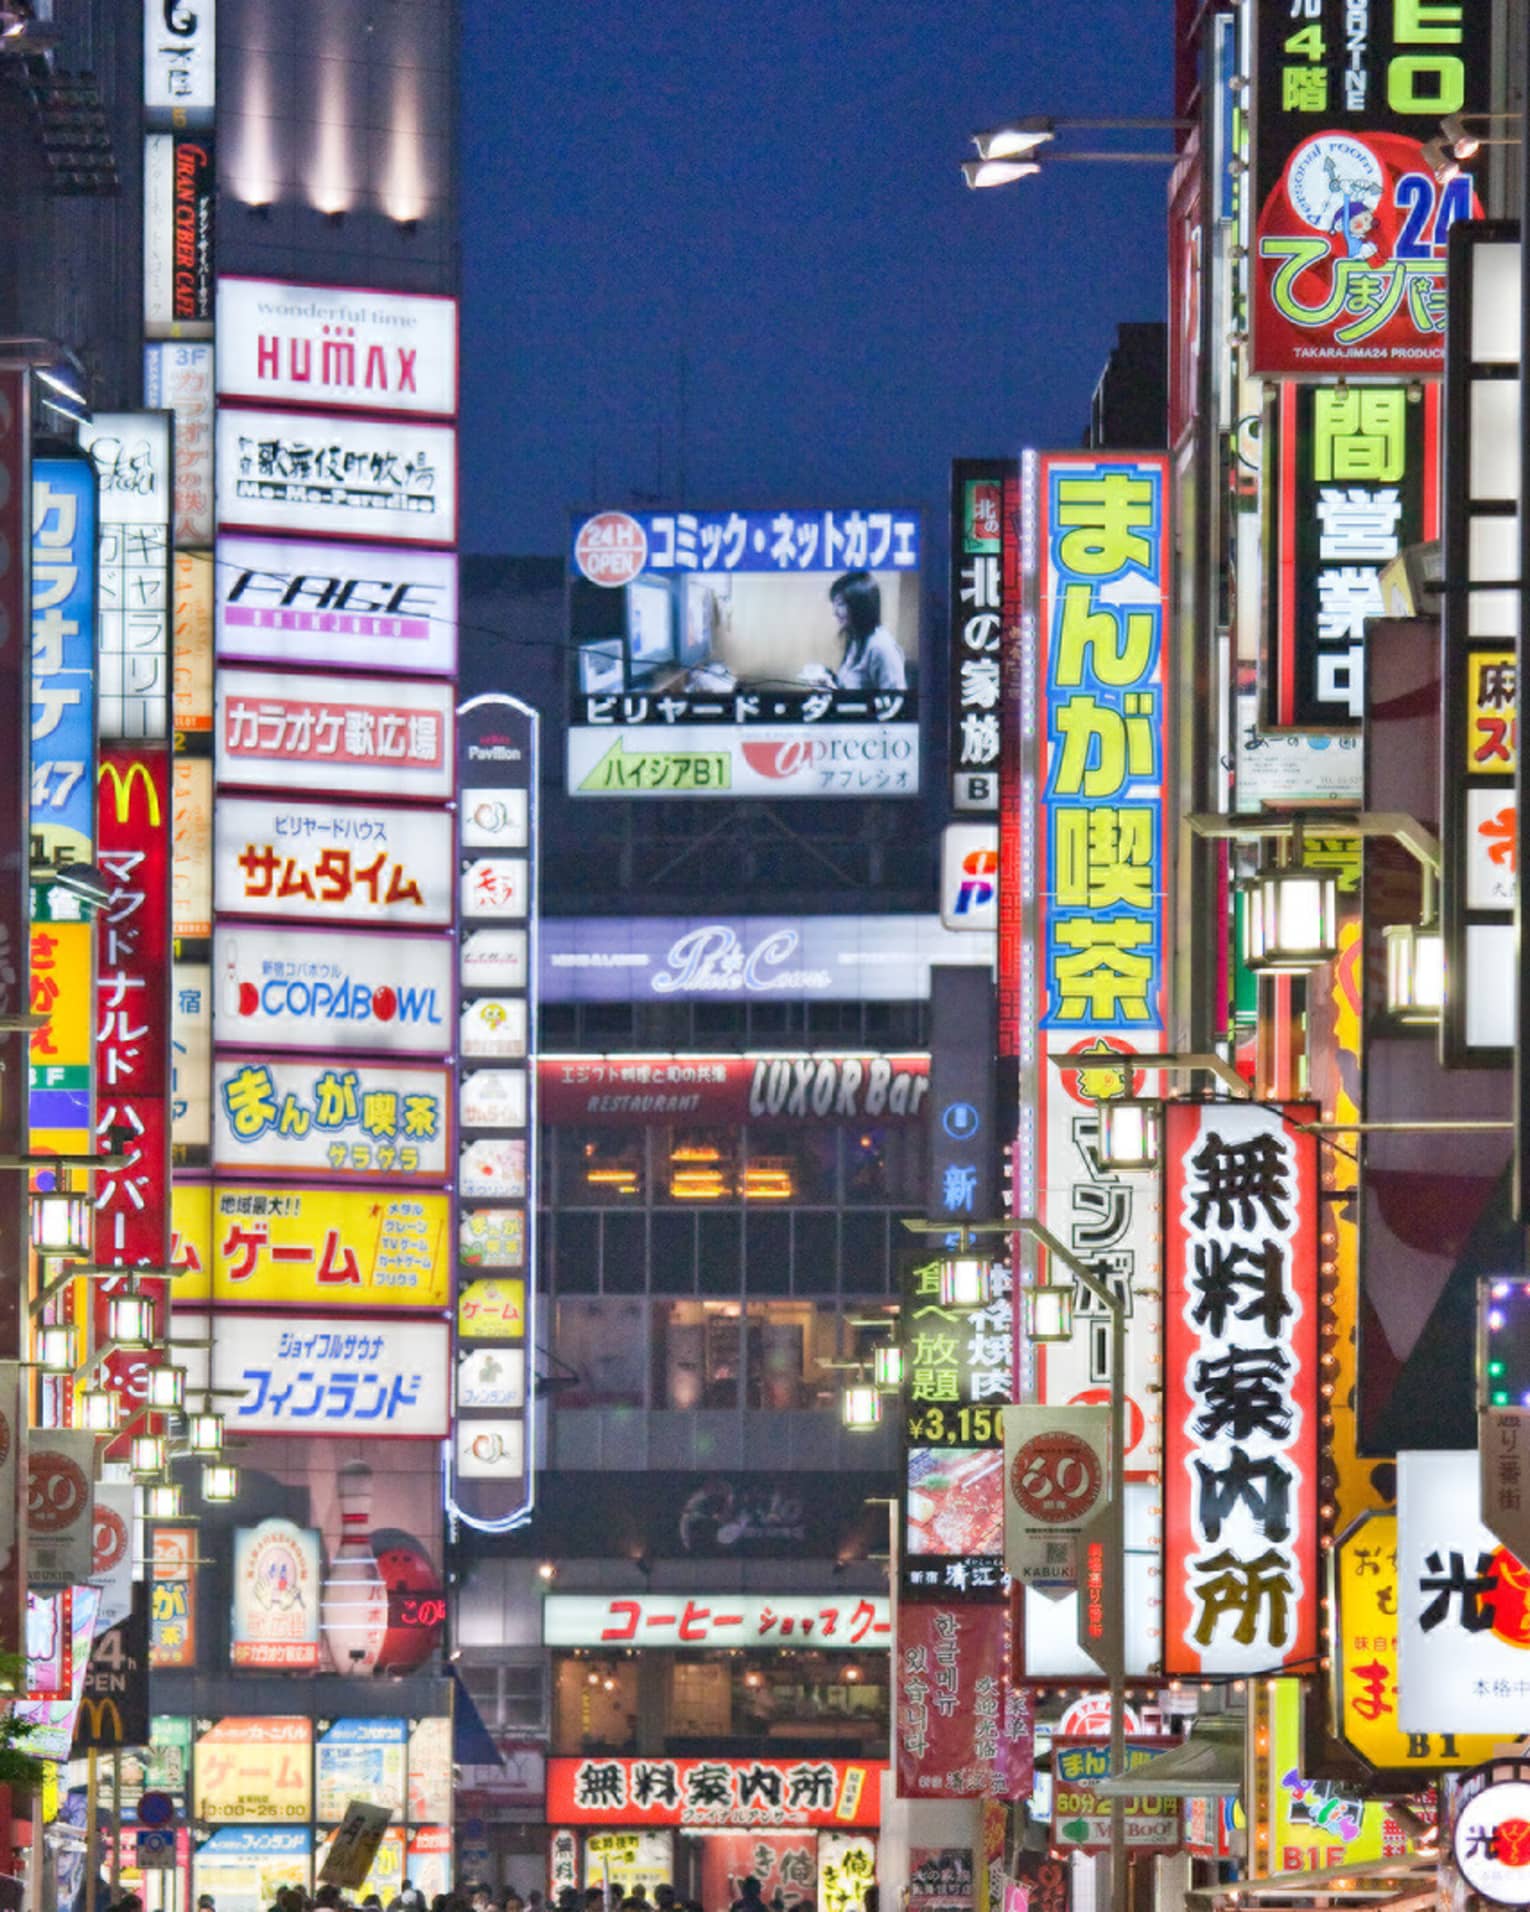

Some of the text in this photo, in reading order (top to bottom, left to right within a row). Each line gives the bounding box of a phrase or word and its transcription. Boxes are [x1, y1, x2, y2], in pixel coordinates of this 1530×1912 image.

[175, 143, 208, 203] GRAN
[1329, 143, 1376, 176] room
[176, 207, 196, 268] CYBER
[1393, 173, 1474, 259] 24
[257, 302, 417, 328] wonderful time
[176, 350, 205, 366] 3F
[258, 325, 416, 393] HUMAX
[1293, 347, 1445, 360] TAKARAJIMA24 PRODUC
[257, 440, 436, 491] 歌舞伎町牧場
[586, 523, 635, 548] 24H
[651, 512, 916, 570] コミック・ネットカフェ
[586, 553, 635, 576] OPEN
[227, 569, 447, 618] FACE
[127, 528, 166, 738] ギャラリー
[175, 558, 192, 705] PASSAGE
[959, 556, 1001, 765] 北の家族
[1476, 660, 1517, 710] 麻
[228, 703, 438, 761] カラオケ歌広場
[587, 695, 904, 724] ビリヤード・ダーツ
[174, 732, 187, 751] 2
[468, 746, 522, 761] Pavilion
[1053, 472, 1155, 1022] まんが喫茶
[1473, 716, 1517, 761] ス
[604, 755, 725, 788] ハイジアB1
[275, 816, 388, 841] ビリヤードハウス
[238, 843, 425, 906] サムタイム
[97, 850, 149, 1085] マクドナルド
[223, 1065, 440, 1142] まんが喫茶
[587, 1094, 700, 1113] RESTAURANT
[748, 1057, 930, 1118] LUXOR Bar
[328, 1143, 420, 1171] ゲラゲラ
[219, 1195, 301, 1216] 地域最大!!
[223, 1223, 361, 1285] ゲーム
[463, 1301, 520, 1321] ゲーム
[278, 1332, 385, 1361] ジョイフルサウナ
[238, 1369, 422, 1420] フィンランド
[1190, 1131, 1295, 1648] 無料案内所
[1022, 1456, 1089, 1498] 60
[85, 1676, 126, 1692] PEN
[934, 1613, 961, 1717] 한글메뉴
[1350, 1658, 1398, 1721] ま
[904, 1647, 928, 1760] 있습니다
[973, 1675, 999, 1760] 欢迎光临
[1003, 1687, 1030, 1742] 菜单
[1406, 1733, 1460, 1758] B1
[203, 1755, 305, 1790] ゲーム
[577, 1762, 835, 1809] 無料案内所
[1283, 1846, 1346, 1872] B1F
